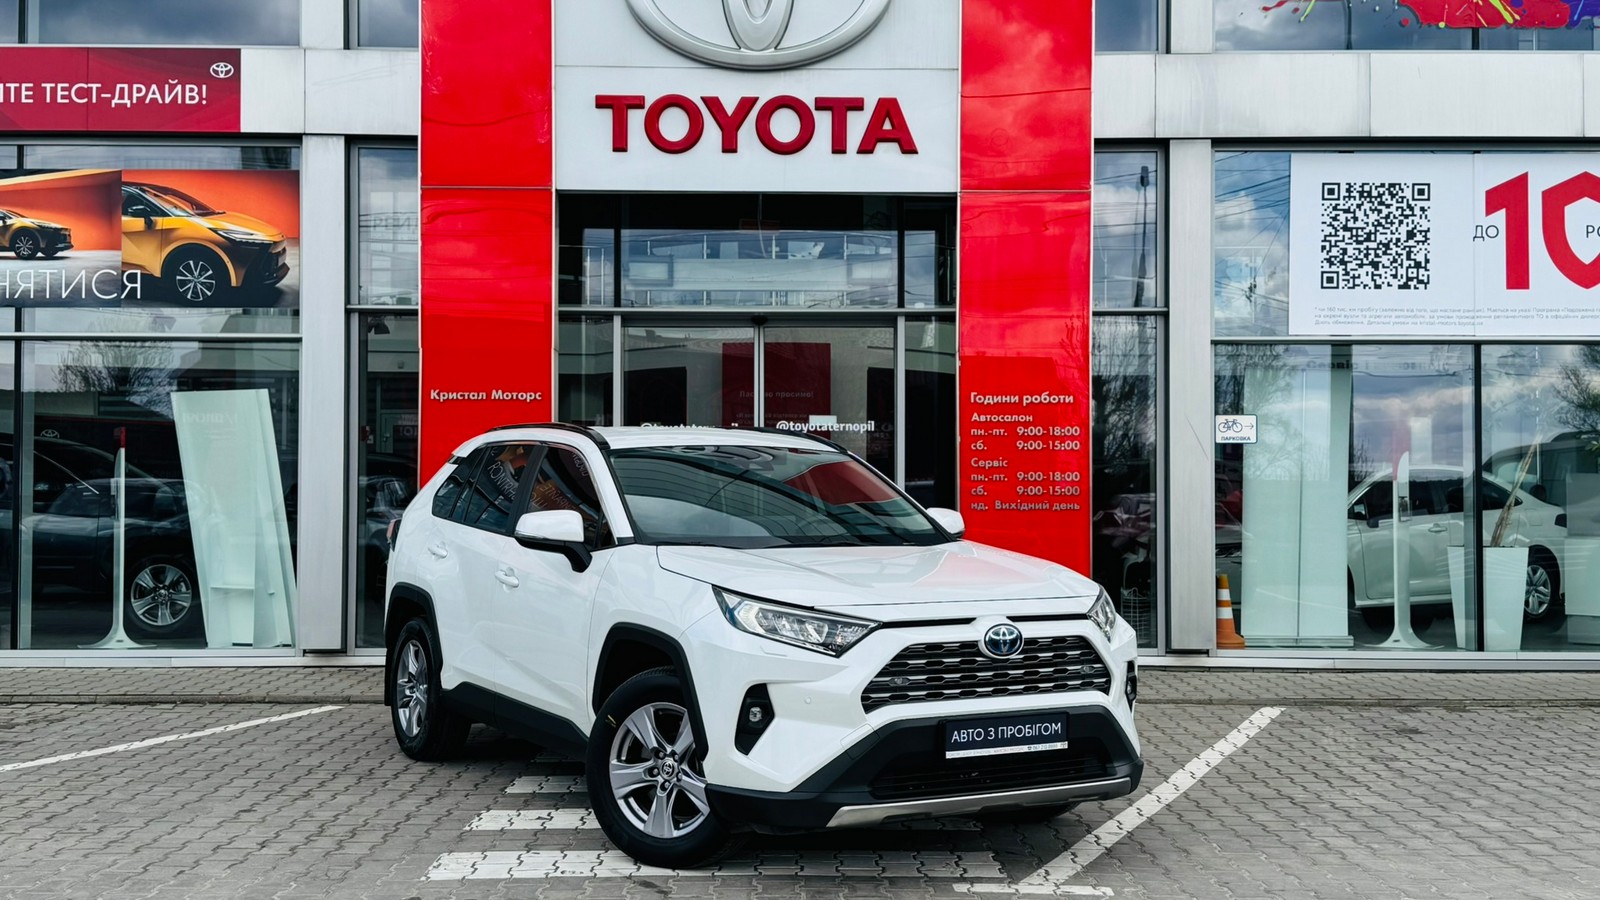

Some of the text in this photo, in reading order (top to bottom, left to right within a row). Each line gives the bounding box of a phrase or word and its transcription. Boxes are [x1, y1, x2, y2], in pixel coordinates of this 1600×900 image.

[0, 79, 207, 108] ТЕ ТЕСТ-ДРАЙВ!
[595, 94, 918, 155] TOYOTA
[1472, 224, 1500, 242] ДО
[1586, 224, 1600, 238] Р
[430, 389, 542, 402] Кристал Моторс
[970, 391, 1074, 406] Години роботи
[971, 412, 1033, 422] Автосалон
[776, 420, 875, 433] @toyotaternopil
[1016, 426, 1080, 436] 9:00-18:00
[971, 440, 1080, 450] сб. 9:00-15:00
[971, 457, 1008, 469] Сервіс
[1016, 472, 1080, 482] 9:00-18:00
[971, 486, 1080, 496] сб. 9:00-15:00
[971, 500, 1080, 510] нд. Вихідний день
[951, 722, 1061, 743] АВТО З ПРОБІГОМ
